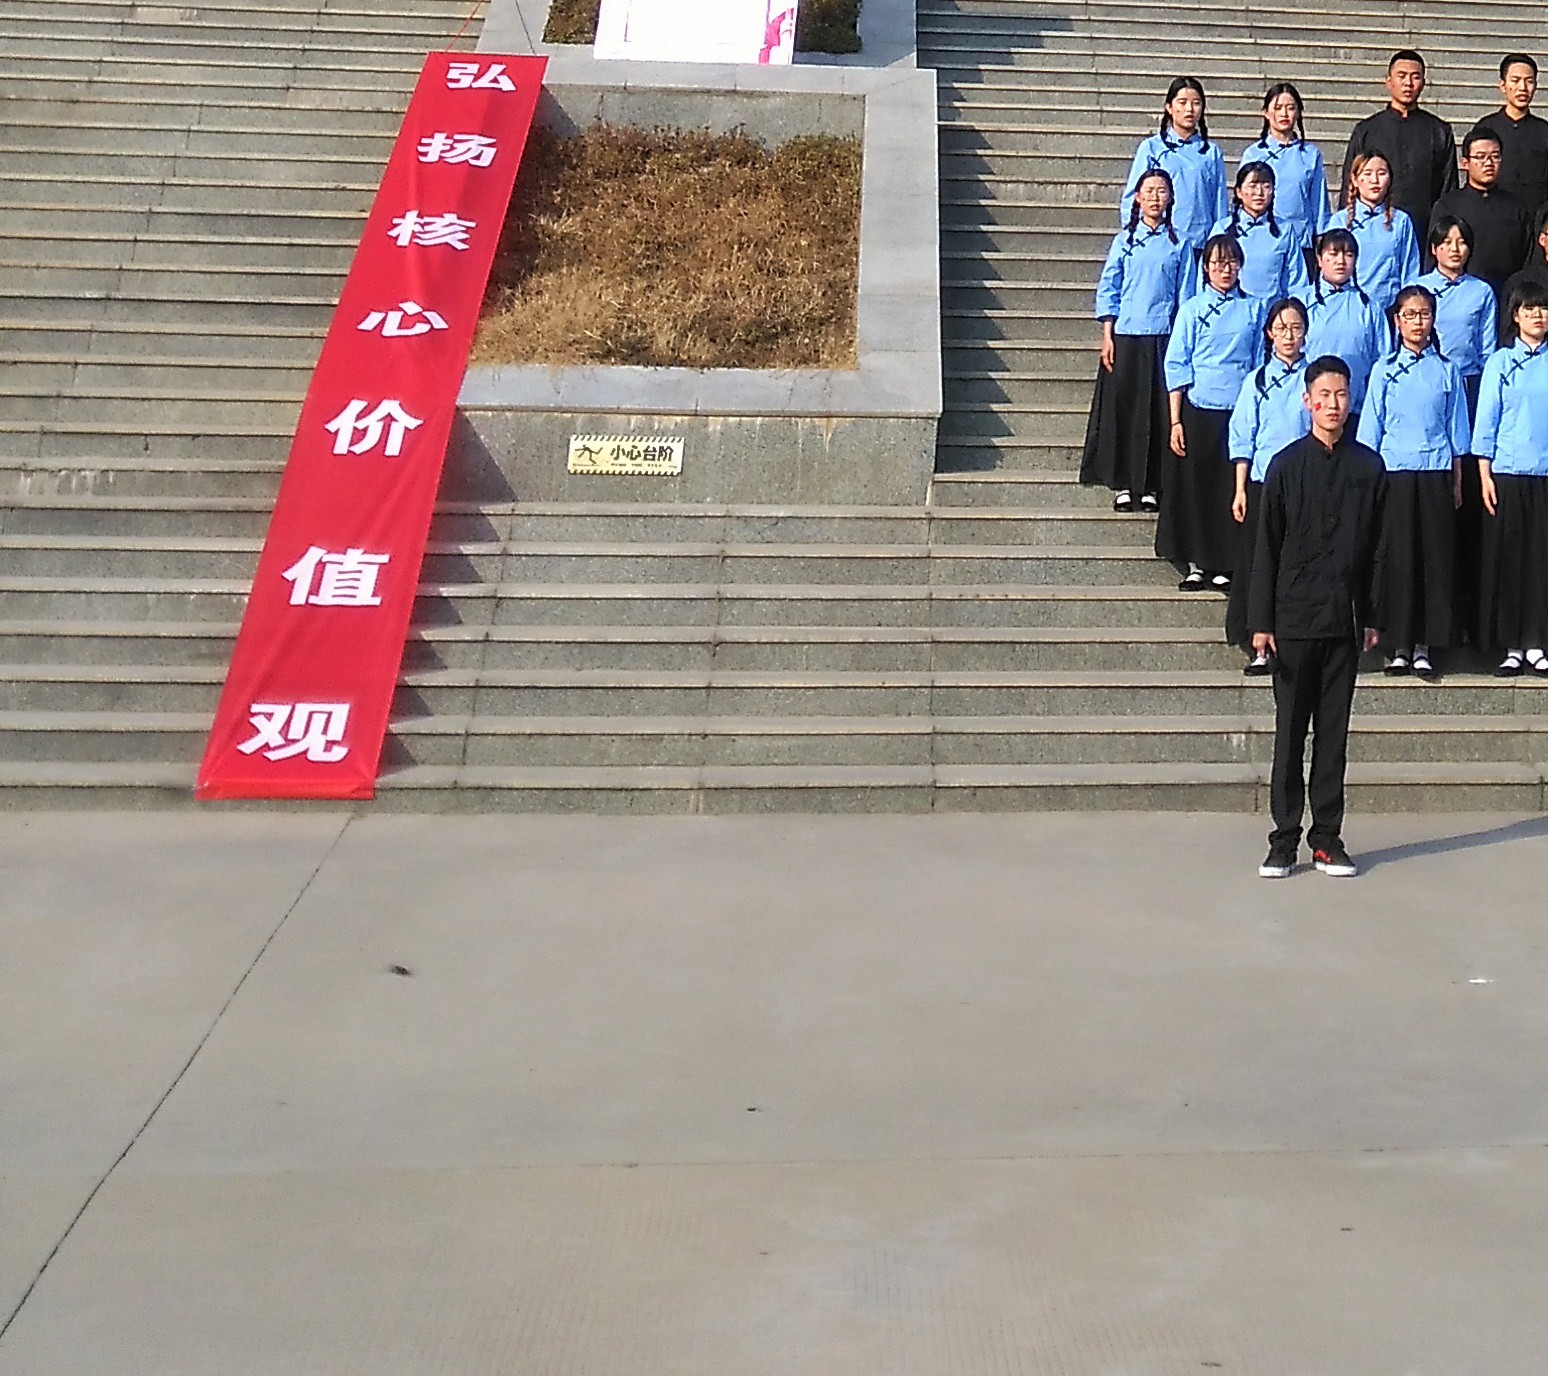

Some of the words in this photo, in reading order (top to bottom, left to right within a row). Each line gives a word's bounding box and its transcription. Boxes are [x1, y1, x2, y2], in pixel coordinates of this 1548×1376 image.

[236, 62, 517, 764] 弘扬核心价值观
[609, 444, 675, 463] 小心台阶
